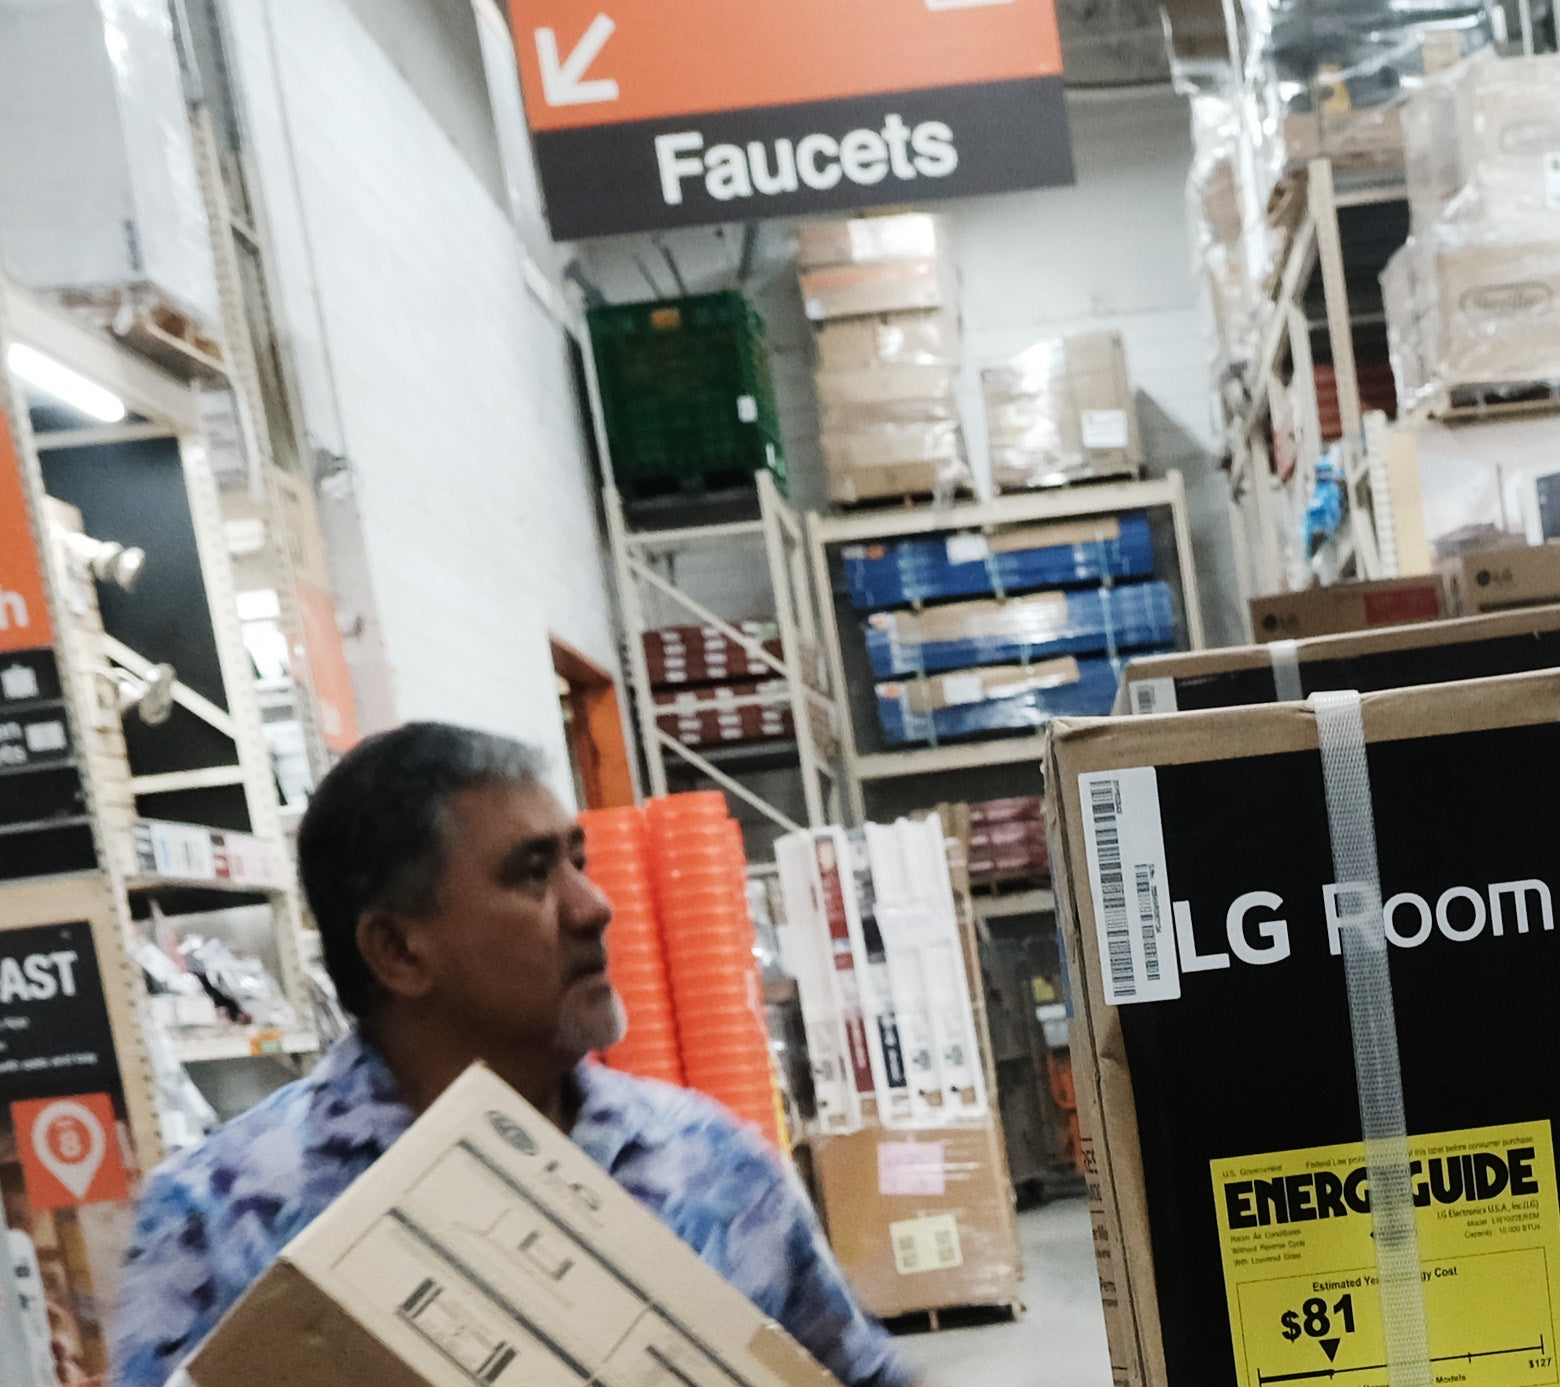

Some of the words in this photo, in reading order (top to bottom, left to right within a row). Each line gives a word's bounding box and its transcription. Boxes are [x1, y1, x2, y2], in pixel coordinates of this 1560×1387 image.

[654, 114, 959, 205] Faucets
[1173, 891, 1290, 974] LG
[1321, 872, 1554, 956] Room
[1312, 1276, 1360, 1292] Estimated
[1432, 1265, 1458, 1280] Cost
[1281, 1294, 1356, 1342] $81
[1529, 1358, 1552, 1370] $127
